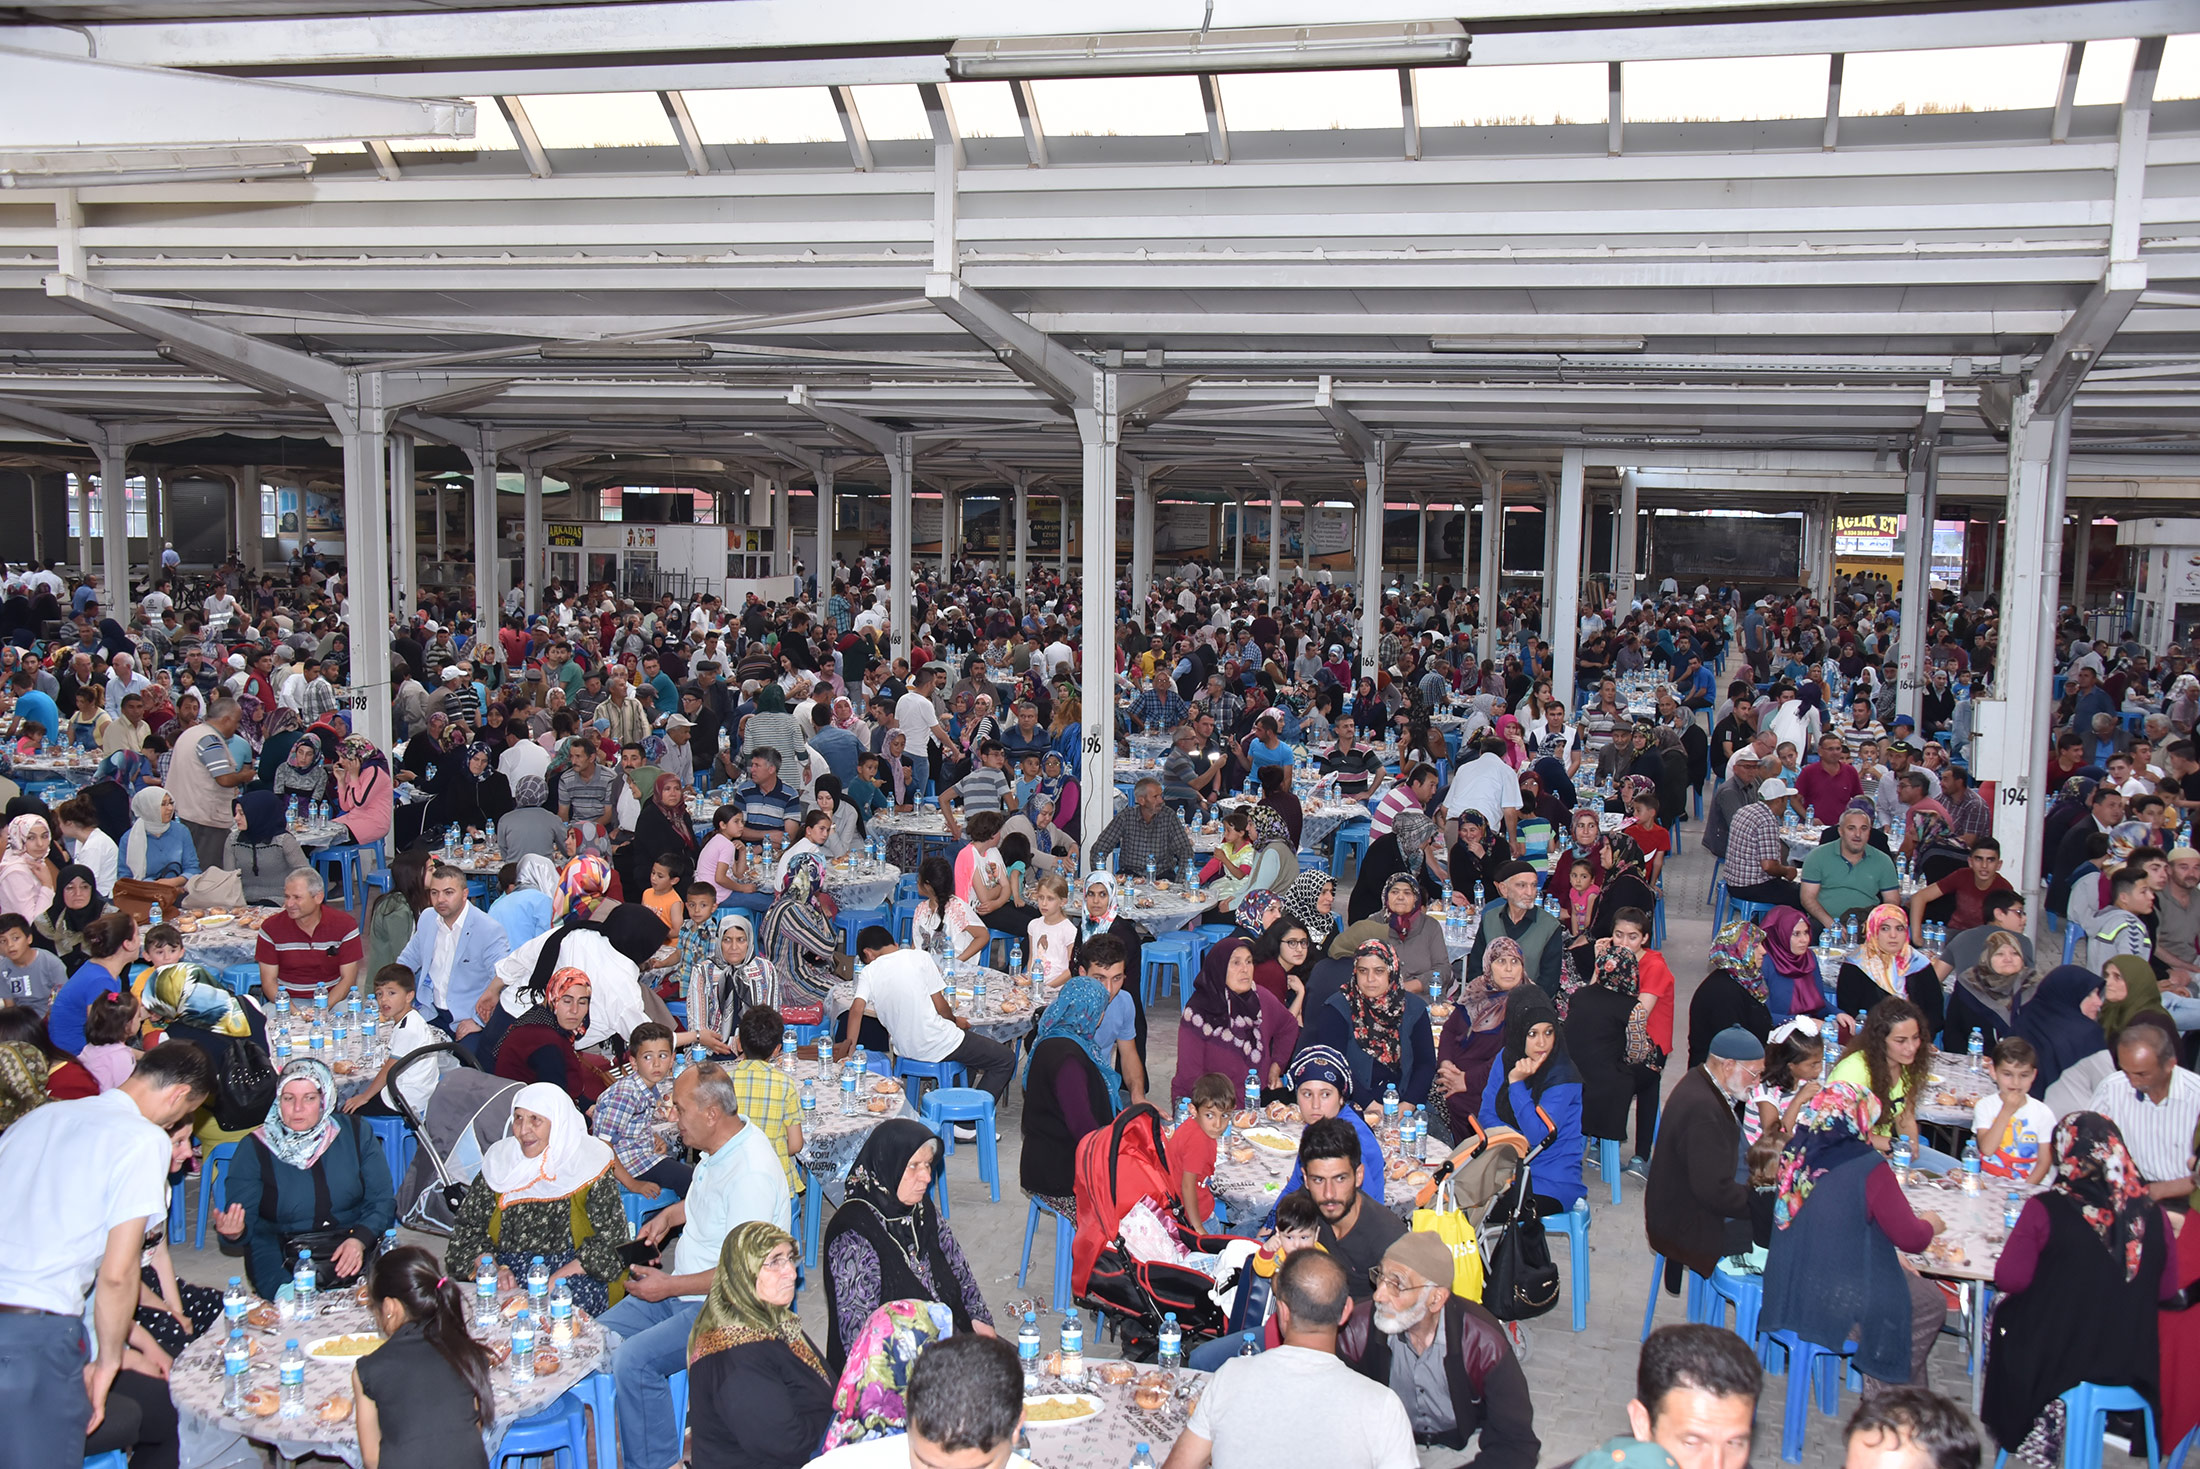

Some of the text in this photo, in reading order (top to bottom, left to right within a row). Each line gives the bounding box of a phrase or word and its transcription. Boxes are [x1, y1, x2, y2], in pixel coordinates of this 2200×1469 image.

[1879, 516, 1897, 535] ET
[1362, 656, 1375, 667] 166
[1900, 662, 1908, 670] 19
[1899, 680, 1914, 690] 164
[351, 696, 368, 710] 198
[1082, 737, 1102, 754] 196
[2001, 787, 2028, 806] 194
